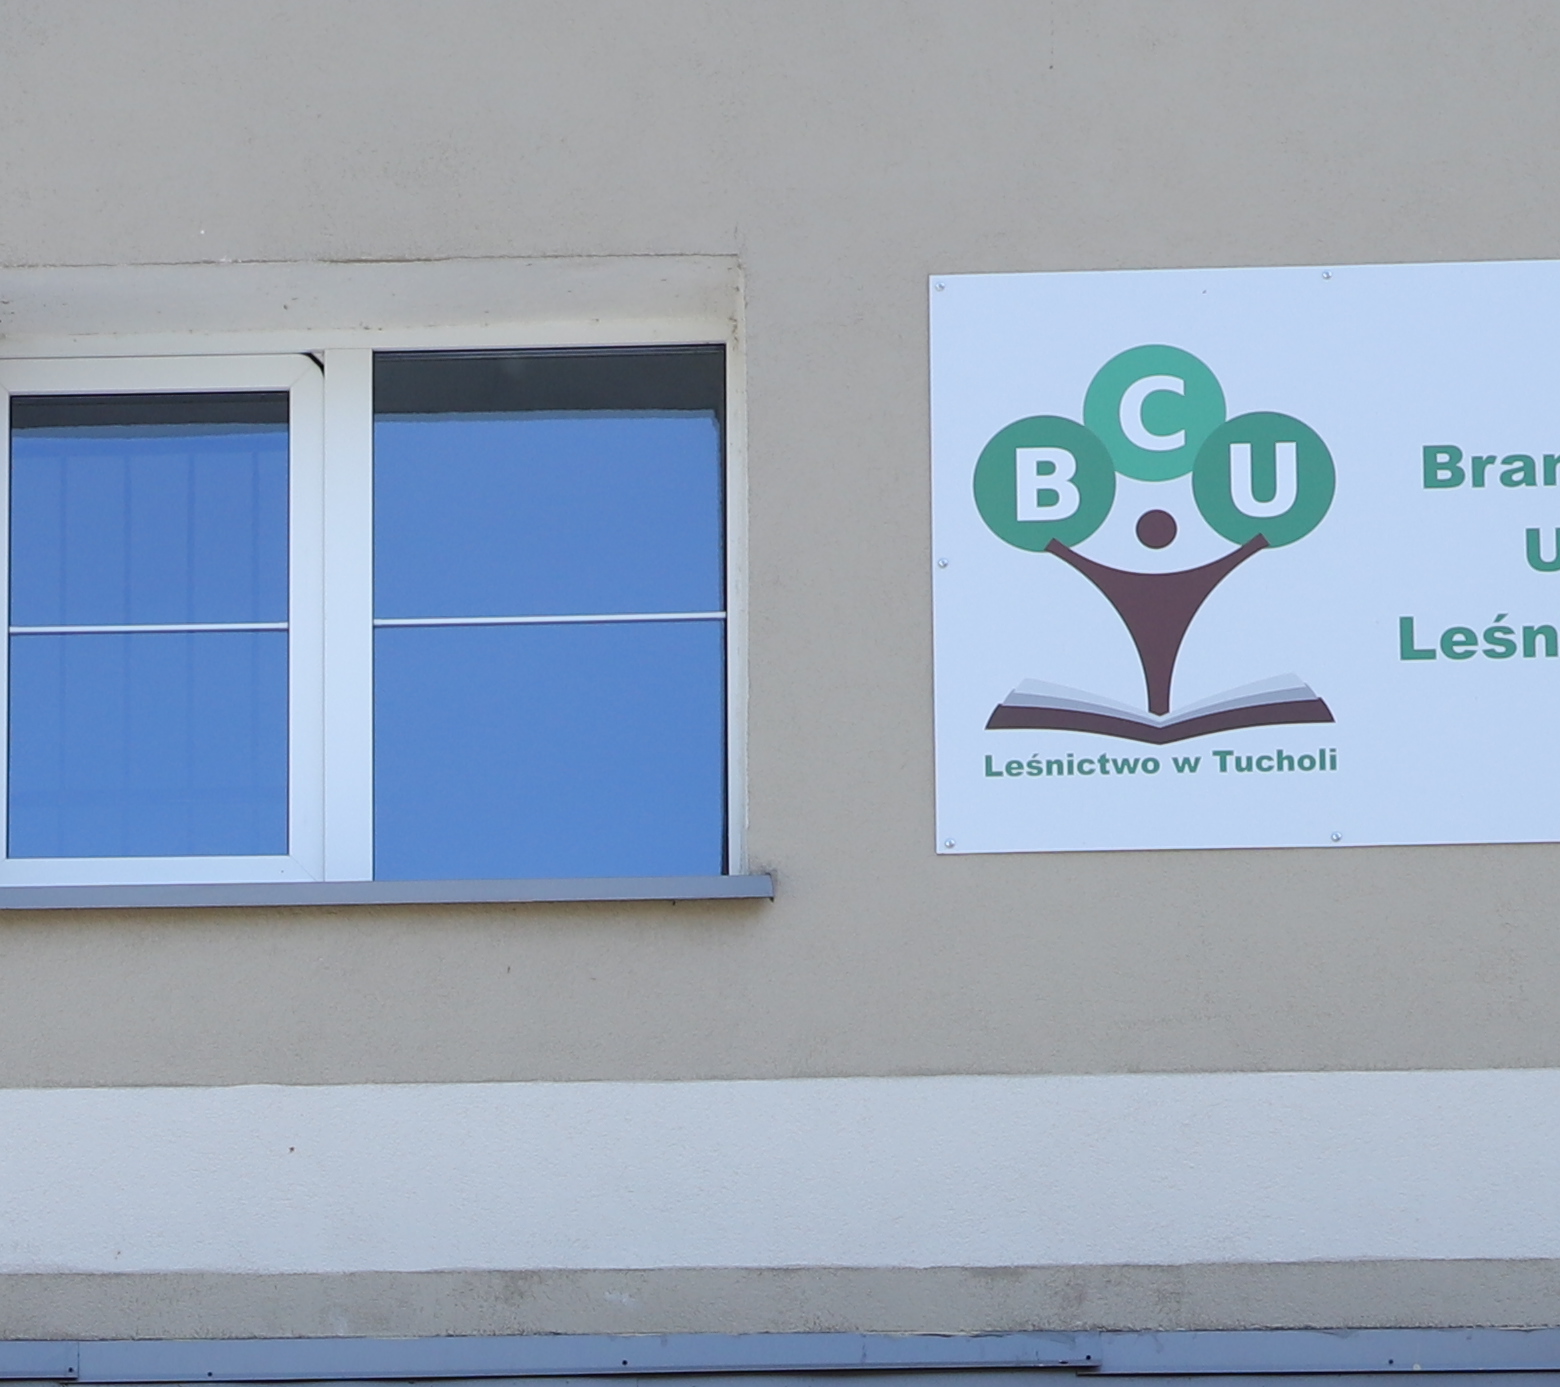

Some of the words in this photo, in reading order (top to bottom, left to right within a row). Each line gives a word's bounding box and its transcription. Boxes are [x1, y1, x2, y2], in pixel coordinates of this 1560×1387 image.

[986, 754, 1159, 776] Leśnictwo
[1173, 757, 1200, 772] w
[1213, 749, 1336, 772] Tucholi
